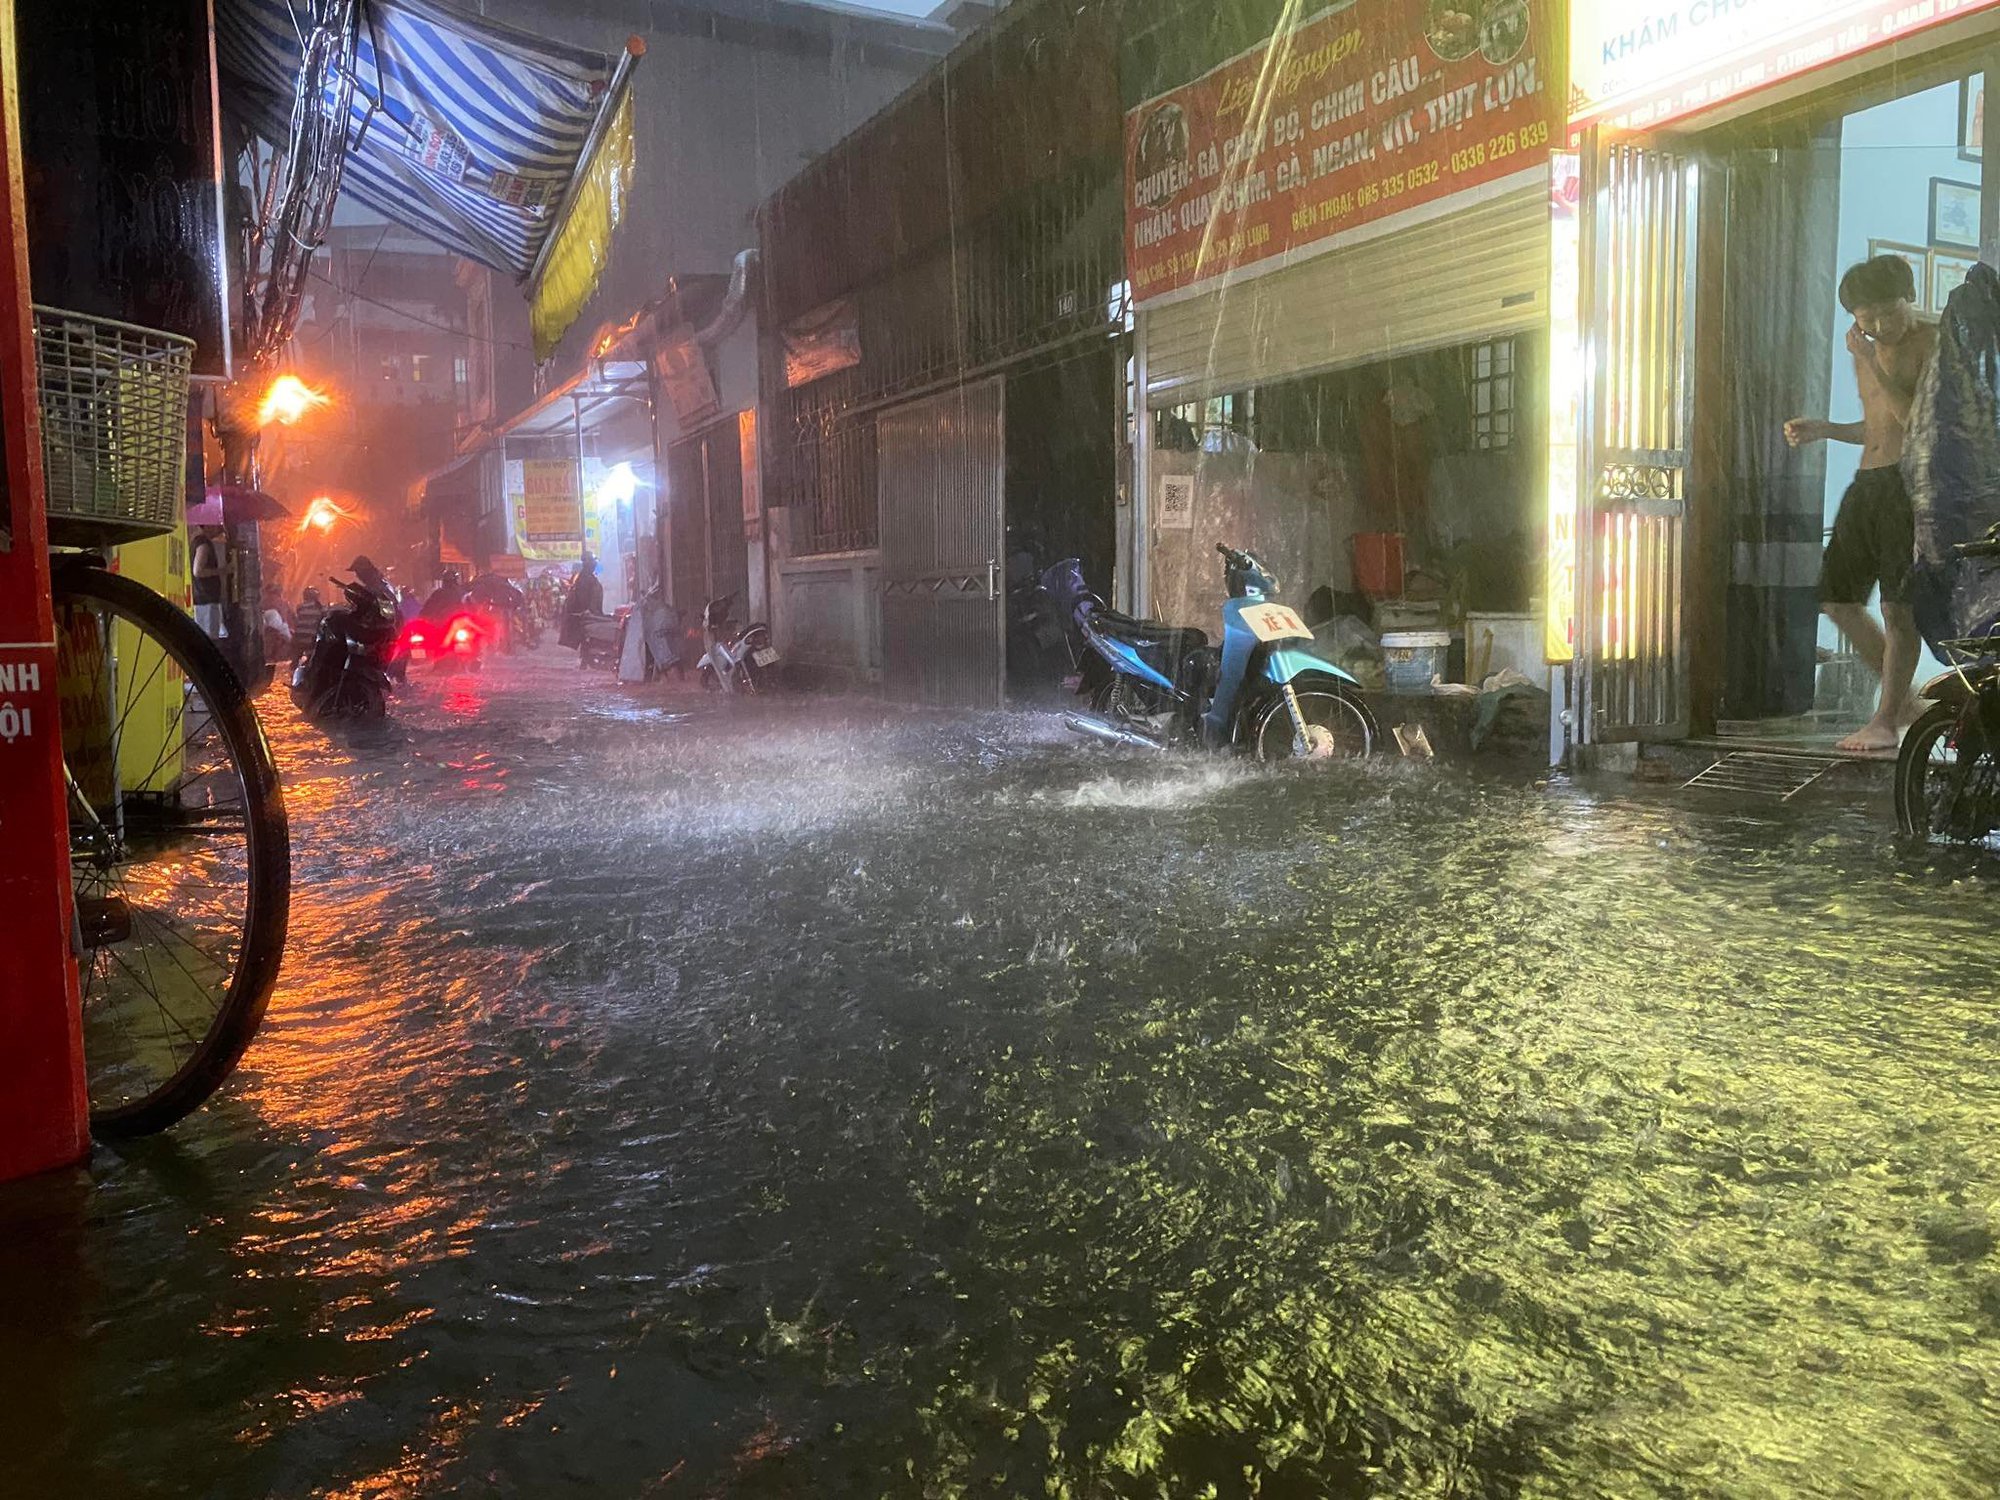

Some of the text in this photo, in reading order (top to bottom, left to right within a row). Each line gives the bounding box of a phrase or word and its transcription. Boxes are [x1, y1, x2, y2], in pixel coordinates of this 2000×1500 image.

[1602, 12, 1678, 65] KHÁM
[1134, 159, 1194, 208] CHUYÊN:
[1198, 141, 1220, 179] GÀ
[1311, 80, 1366, 132] CHIM
[1312, 127, 1376, 179] NGAN,
[1424, 82, 1478, 133] THỊT
[1483, 57, 1544, 113] LỤN.
[1382, 173, 1405, 199] 335
[1407, 160, 1440, 190] 0532
[1451, 144, 1486, 175] 0338
[1488, 132, 1516, 161] 226
[1519, 120, 1549, 150] 839
